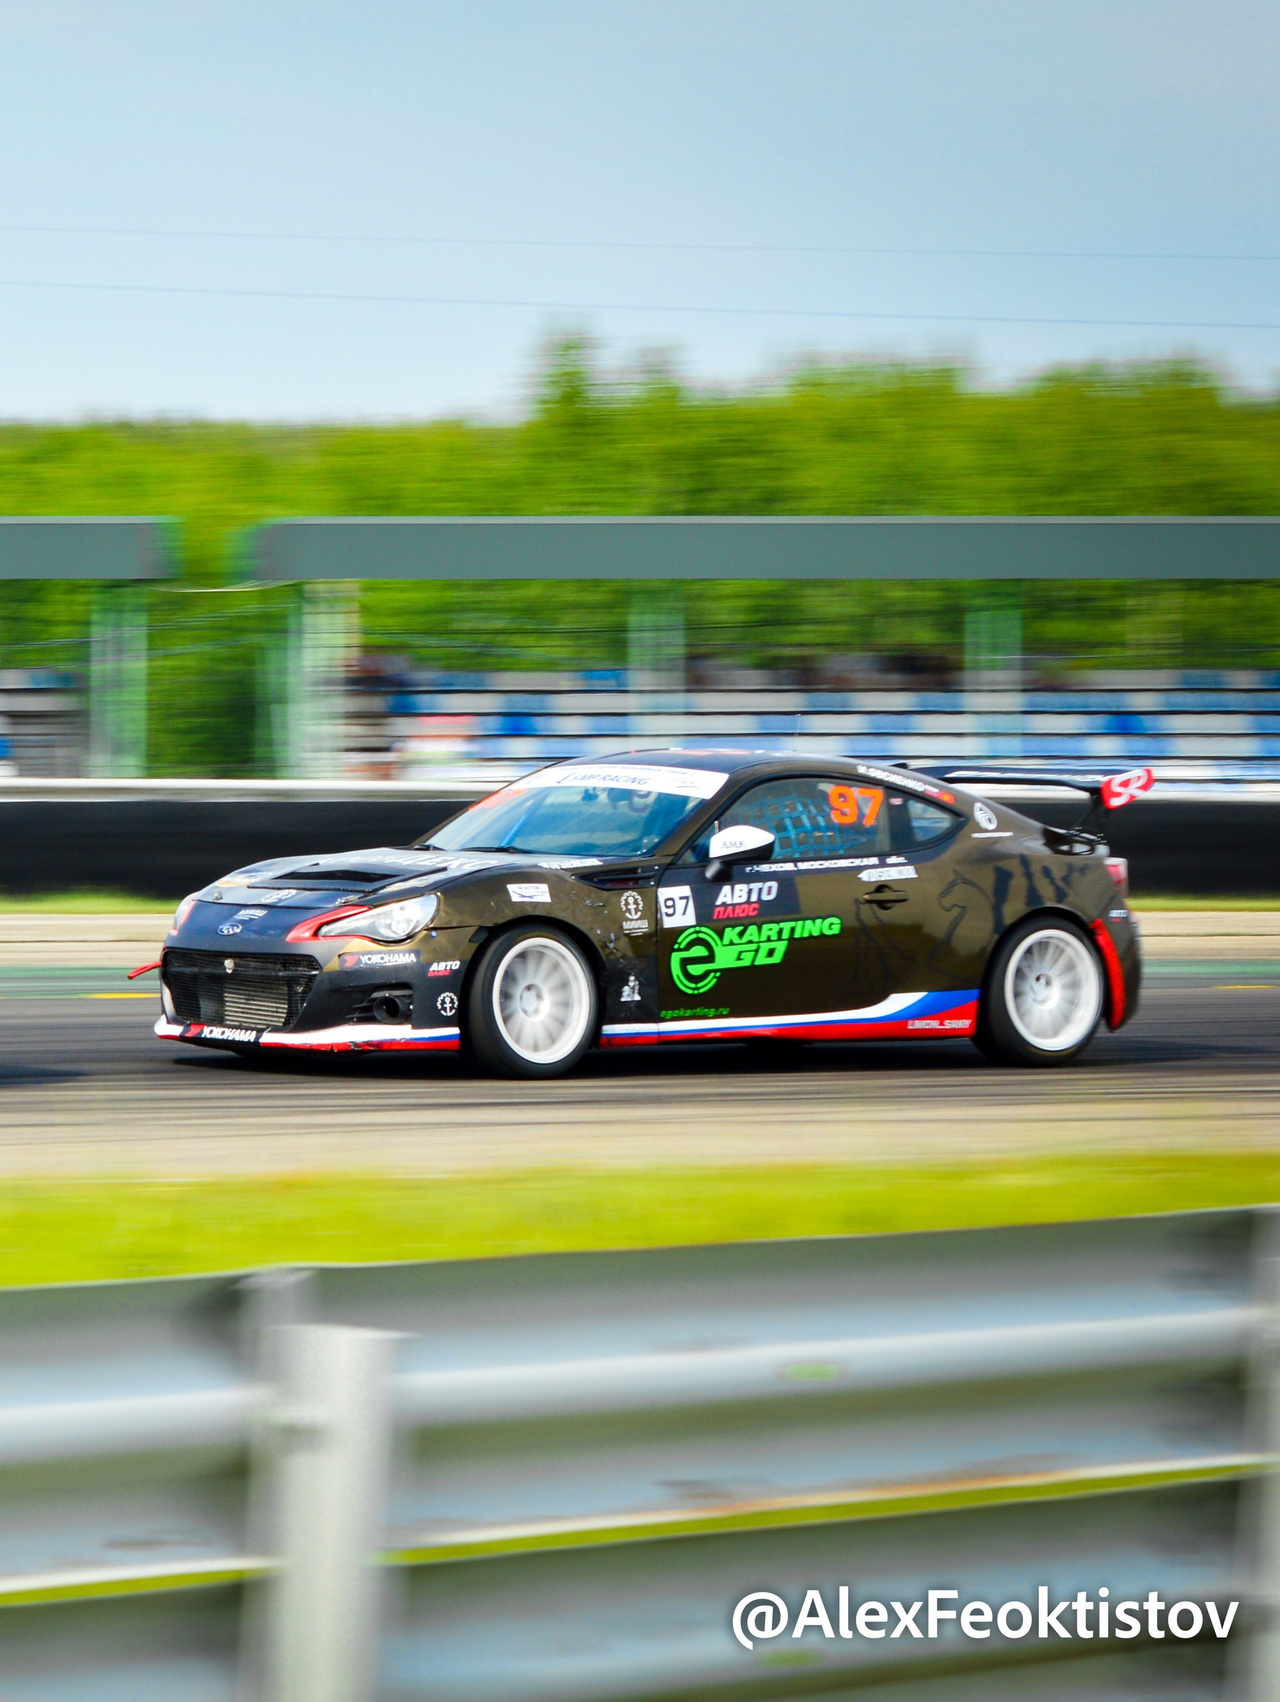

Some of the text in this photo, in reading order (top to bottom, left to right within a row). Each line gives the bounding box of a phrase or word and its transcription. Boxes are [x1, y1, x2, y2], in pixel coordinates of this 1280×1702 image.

[598, 774, 652, 786] RACING
[828, 785, 884, 826] 97
[715, 881, 778, 905] АВТО
[663, 895, 691, 917] 97
[713, 903, 760, 919] ПЛЮС
[722, 917, 842, 945] KARTING
[360, 952, 417, 965] YOKOHAMA
[429, 960, 460, 971] АВТО
[660, 1007, 730, 1019] egokarting.ru
[201, 1025, 257, 1042] YOKOHAMA
